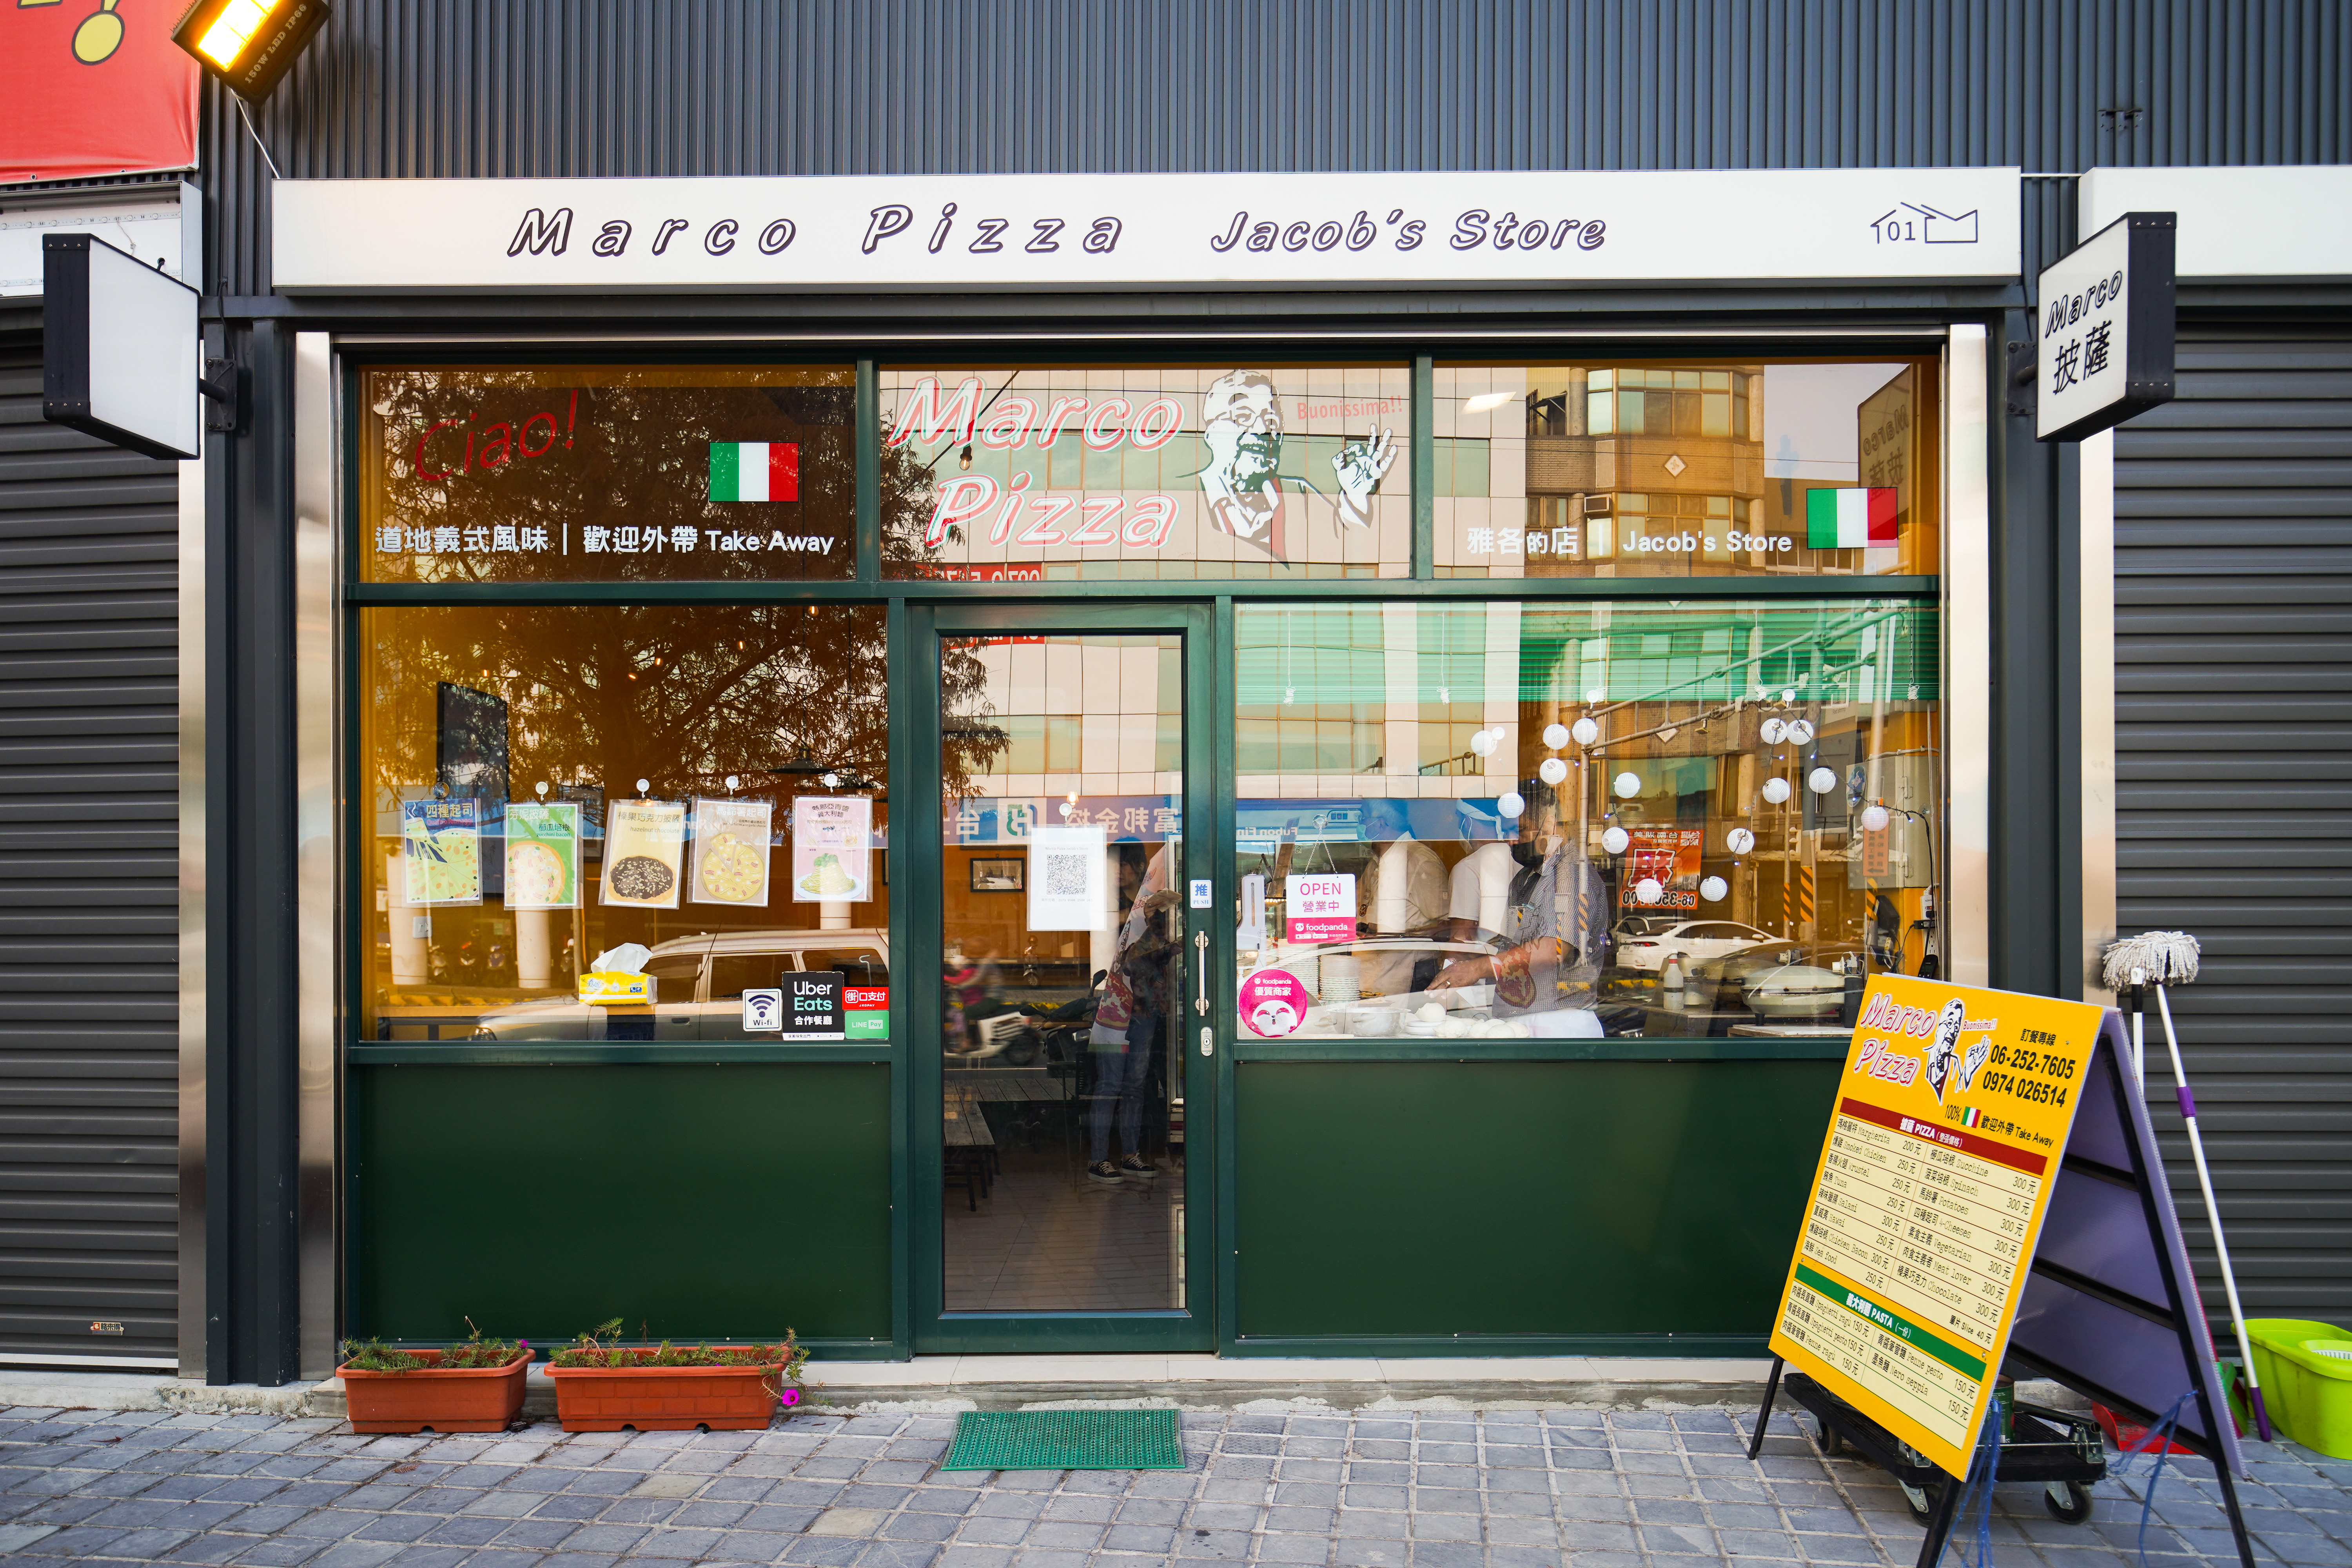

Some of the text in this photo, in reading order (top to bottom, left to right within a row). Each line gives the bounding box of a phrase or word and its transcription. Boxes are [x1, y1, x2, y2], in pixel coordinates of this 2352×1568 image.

[245, 4, 307, 83] 150W LED IP66
[506, 202, 1607, 258] Marco Pizza Jacob's Store
[2045, 270, 2123, 339] Marco
[2053, 320, 2112, 396] 披薩
[886, 375, 1185, 452] Marco
[1296, 394, 1403, 420] Buonissima!!
[414, 389, 579, 481] Ciao!
[925, 470, 1180, 548] Pizza
[375, 526, 835, 555] 道地義式風味 歡迎外帶 Take Away
[1467, 526, 1792, 555] 雅各的店 Jacob's Store
[426, 803, 473, 818] 四種起司
[510, 808, 549, 820] 芬妮披薩
[618, 811, 681, 823] 榛果巧克力披薩
[717, 806, 766, 818] 馬鈴薯起司
[1195, 884, 1208, 896] 推
[1300, 883, 1341, 895] OPEN
[1303, 900, 1339, 913] 營業中
[1306, 923, 1348, 932] foodpanda
[794, 981, 833, 995] Uber
[794, 997, 833, 1011] Eats
[1254, 987, 1291, 996] 優質商家
[794, 1015, 833, 1025] 合作餐廳
[1860, 993, 1937, 1039] Marco
[1963, 1020, 1996, 1030] Buonissima!!
[2020, 1029, 2056, 1046] 訂餐專線
[1853, 1038, 1920, 1087] Pizza
[1991, 1044, 2076, 1079] 06-252-7605
[1983, 1071, 2067, 1108] 0974 026514
[1837, 1118, 1913, 1151] 瑪格麗特 Margherita 200
[1900, 1117, 1915, 1133] 披薩
[1915, 1123, 1936, 1139] PIZZA
[1945, 1104, 2054, 1148] 100% 歡迎外帶 Take Away
[1832, 1136, 1909, 1170] 燻雞 Smoked Chicken 250
[1930, 1148, 2027, 1189] 櫛瓜培根 Zucchine 300
[1823, 1170, 1898, 1209] 鮪魚 Tuna 250
[1828, 1153, 1903, 1190] 香腸火腿 Wrustel 250
[1924, 1168, 2020, 1210] 菠菜培根 Spinach 300
[1813, 1205, 1887, 1246] 夏威夷 Hawai 250
[1838, 1198, 1858, 1212] Salami
[1882, 1216, 1893, 1227] 300
[1919, 1187, 2014, 1232] 馬鈴薯 Potatoes 300
[1808, 1222, 1882, 1265] 燻雞培根 Chicken Bacon 300
[1913, 1207, 2008, 1253] 四種起司 4-Cheeses 300
[1804, 1240, 1877, 1284] 海鮮 Sea food 250
[1908, 1226, 2002, 1274] 素食主義 Vegetarian 300
[1902, 1246, 1996, 1296] 肉食主義者 Meat lover 300
[1897, 1264, 1989, 1317] 榛果巧克力 Chocolate 300
[1815, 1299, 1838, 1318] Spaghetti
[1839, 1313, 1851, 1327] ragù
[1853, 1320, 1862, 1334] 150
[1846, 1292, 1873, 1317] 義大利麵
[1871, 1307, 1893, 1328] PASTA
[1949, 1315, 1984, 1339] 單片 Slice 40
[1805, 1334, 1821, 1350] Penne
[1822, 1345, 1836, 1361] ragù
[1842, 1357, 1852, 1370] 150
[1810, 1317, 1834, 1337] Spaghetti
[1834, 1331, 1847, 1346] pesto
[1848, 1339, 1857, 1352] 150
[1871, 1353, 1960, 1414] 墨魚麵 Nero seppia 150
[1907, 1352, 1925, 1369] Penne
[1925, 1364, 1944, 1380] pesto
[1955, 1379, 1966, 1393] 150
